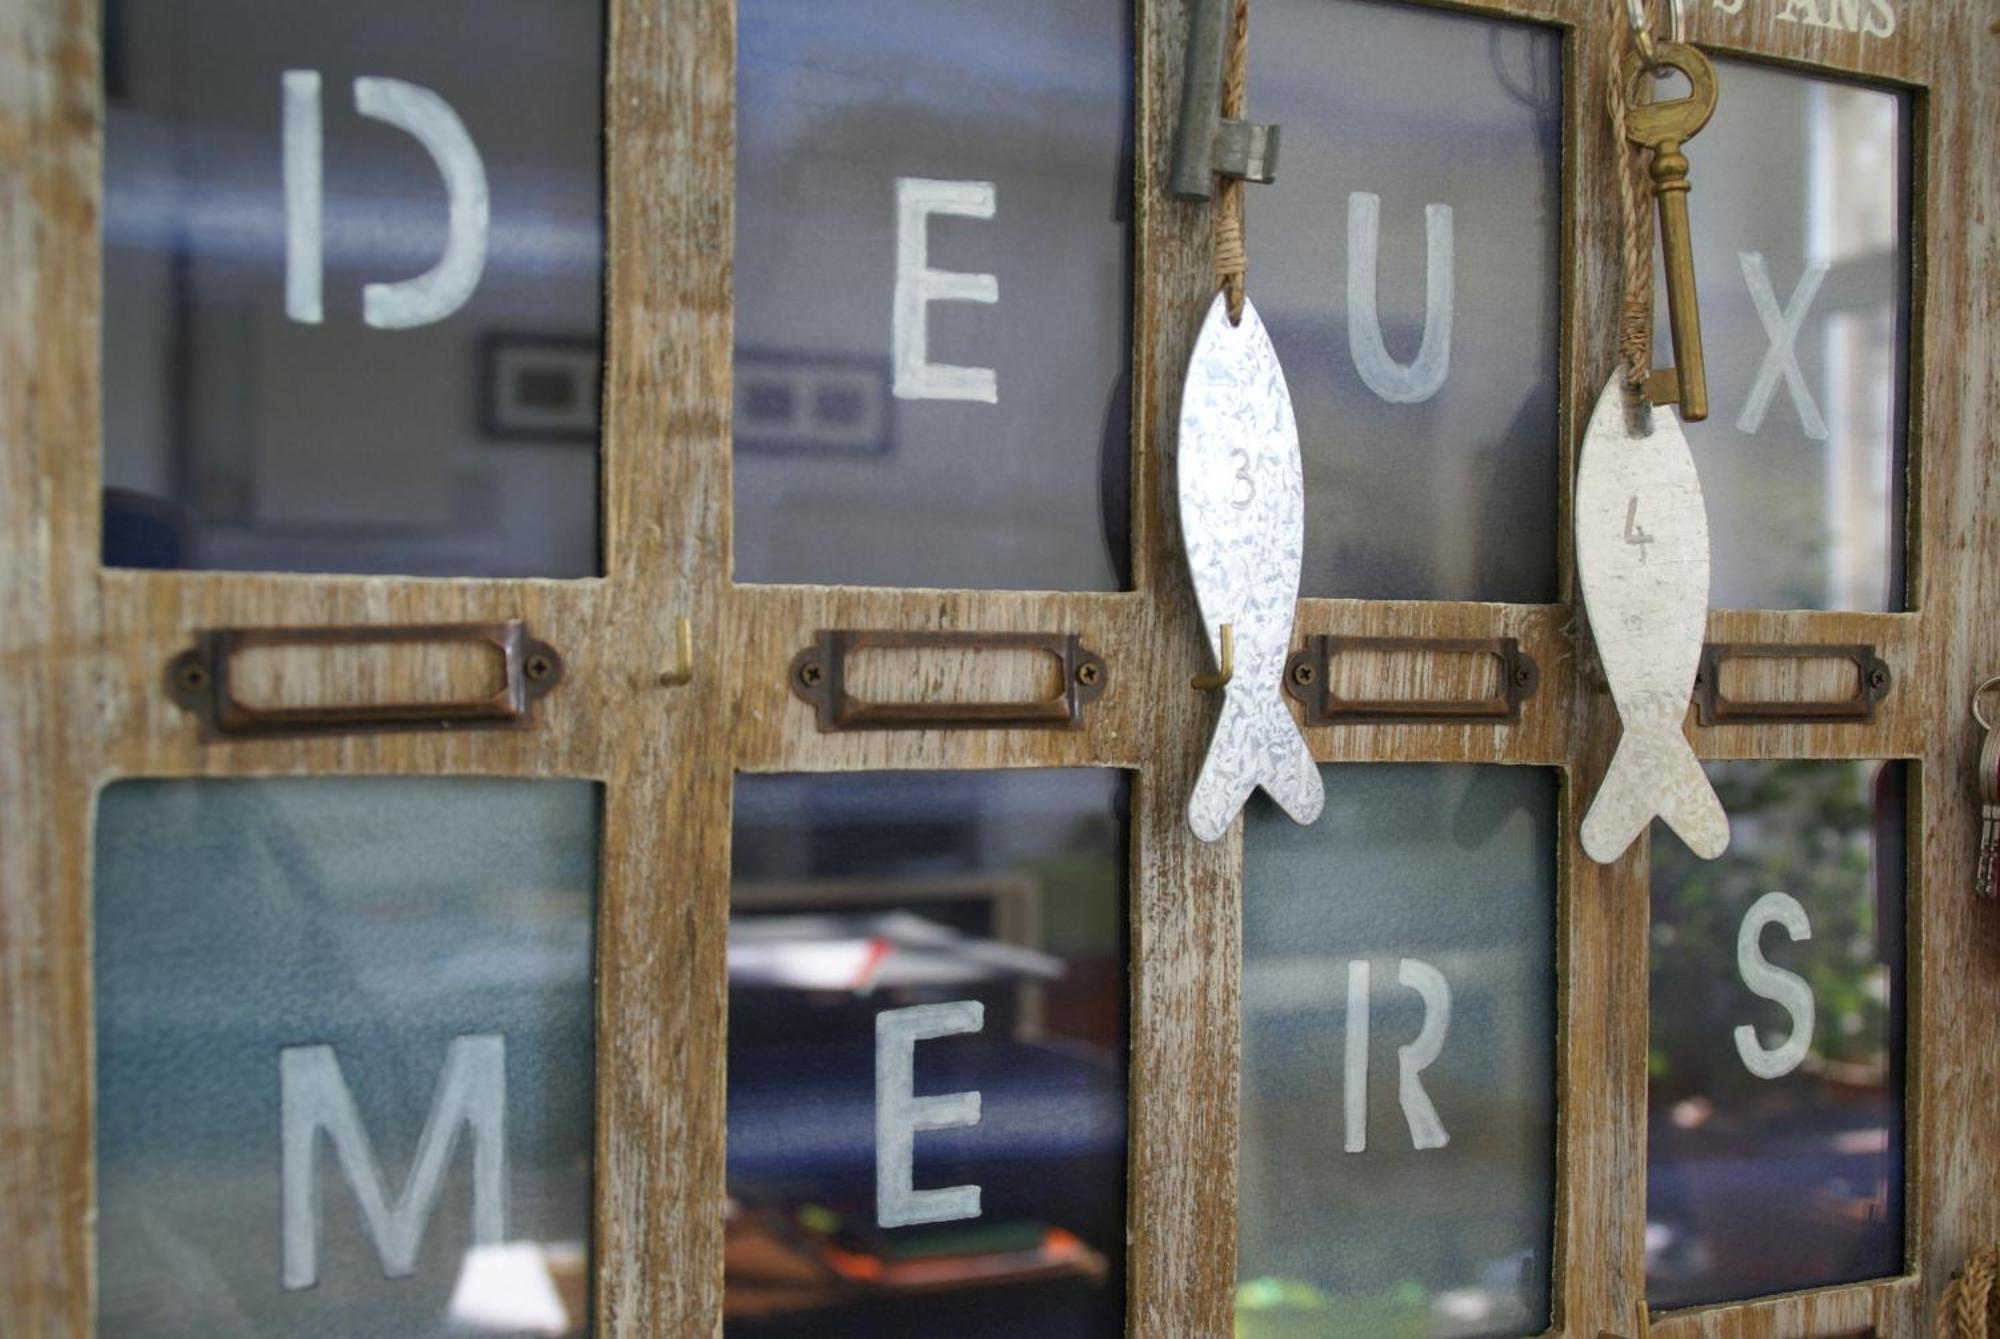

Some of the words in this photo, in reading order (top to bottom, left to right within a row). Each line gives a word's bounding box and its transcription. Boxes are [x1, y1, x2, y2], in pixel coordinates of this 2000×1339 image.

[281, 69, 490, 330] D
[891, 177, 998, 403] E
[1347, 191, 1454, 404] U
[1735, 252, 1830, 442] X
[1229, 447, 1257, 511] 3
[1624, 496, 1654, 563] 4
[280, 1035, 507, 1290] M
[875, 1000, 985, 1229] E
[1343, 957, 1452, 1153] R
[1734, 891, 1816, 1080] S
